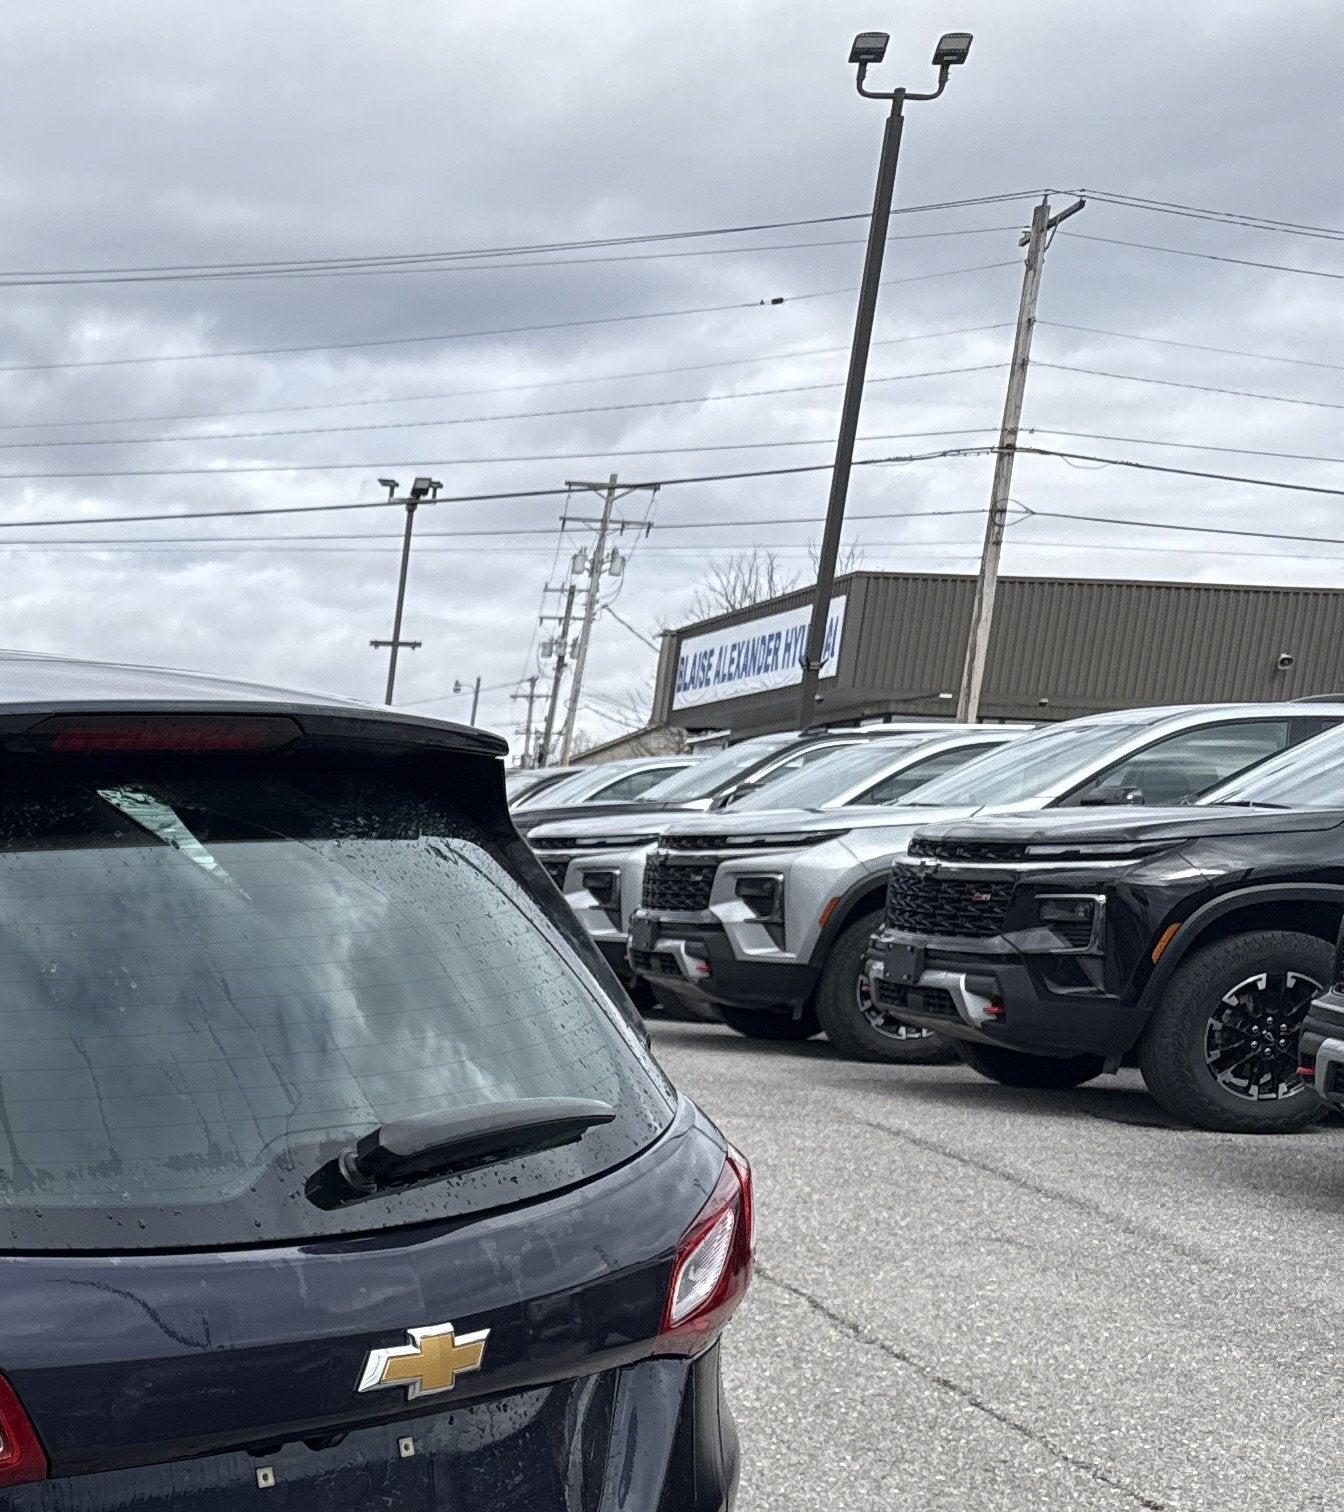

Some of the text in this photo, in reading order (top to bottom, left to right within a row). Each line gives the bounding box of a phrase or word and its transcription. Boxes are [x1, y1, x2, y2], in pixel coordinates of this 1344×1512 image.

[676, 616, 839, 693] BLAISE ALEXANDER HYUAI
